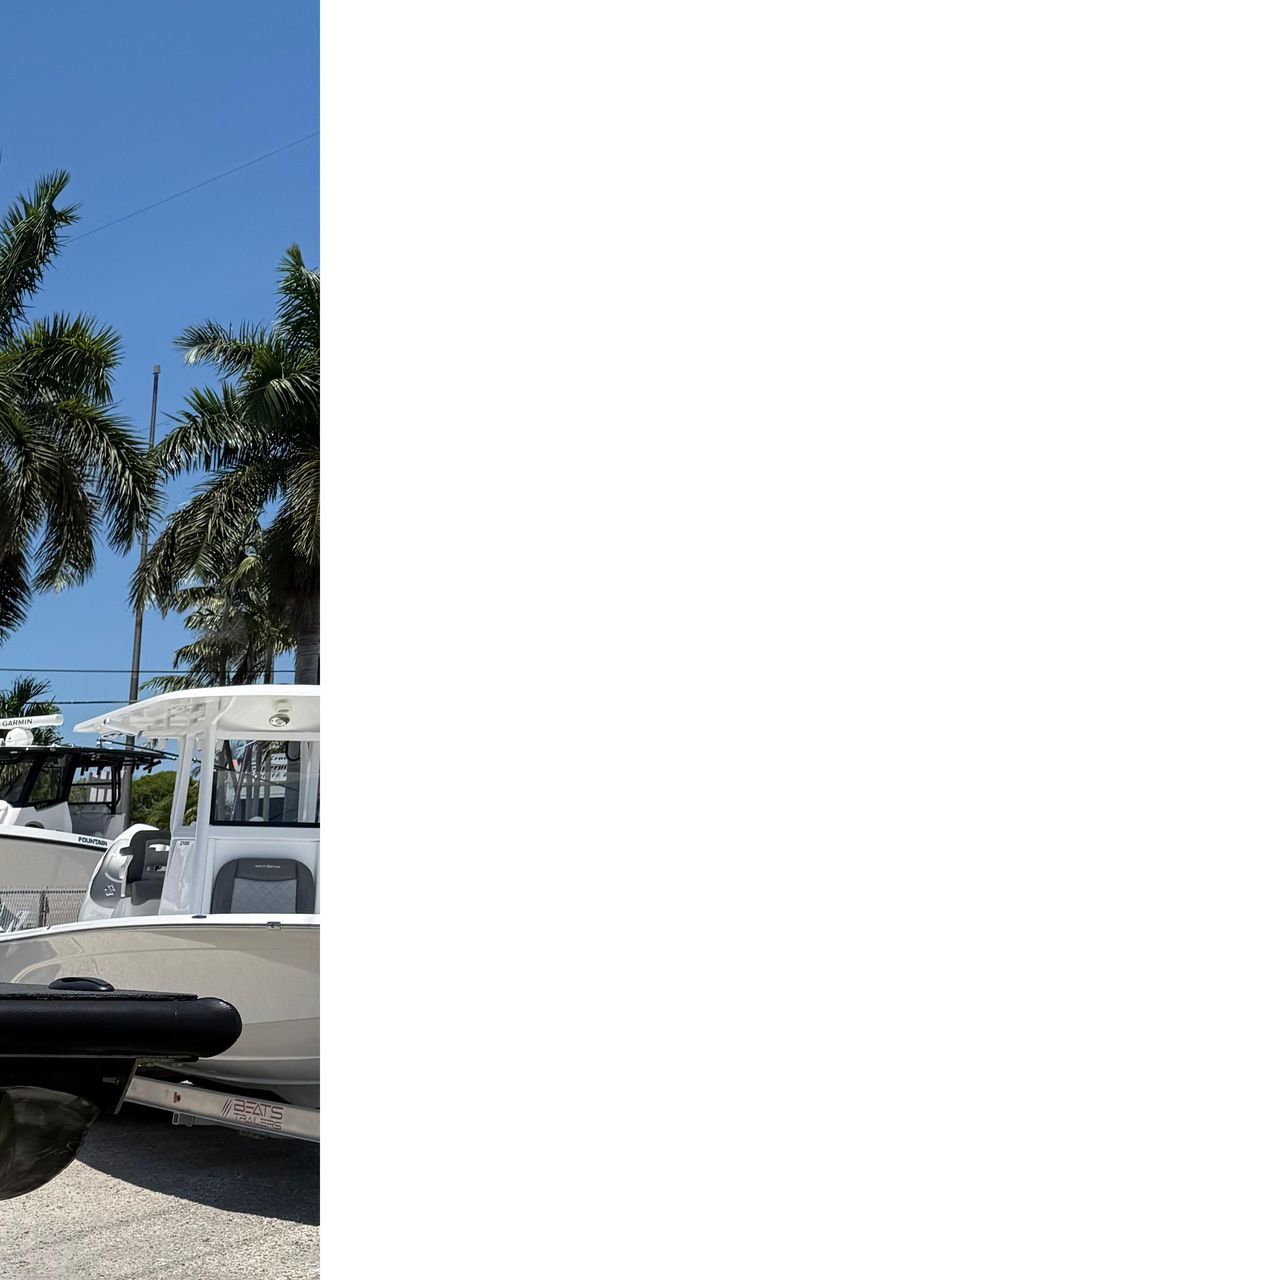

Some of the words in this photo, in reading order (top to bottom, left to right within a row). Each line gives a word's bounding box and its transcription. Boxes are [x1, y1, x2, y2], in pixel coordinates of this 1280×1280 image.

[2, 719, 33, 727] GARMIN
[233, 1098, 284, 1120] BEATS
[233, 1112, 282, 1131] TRAILERS
